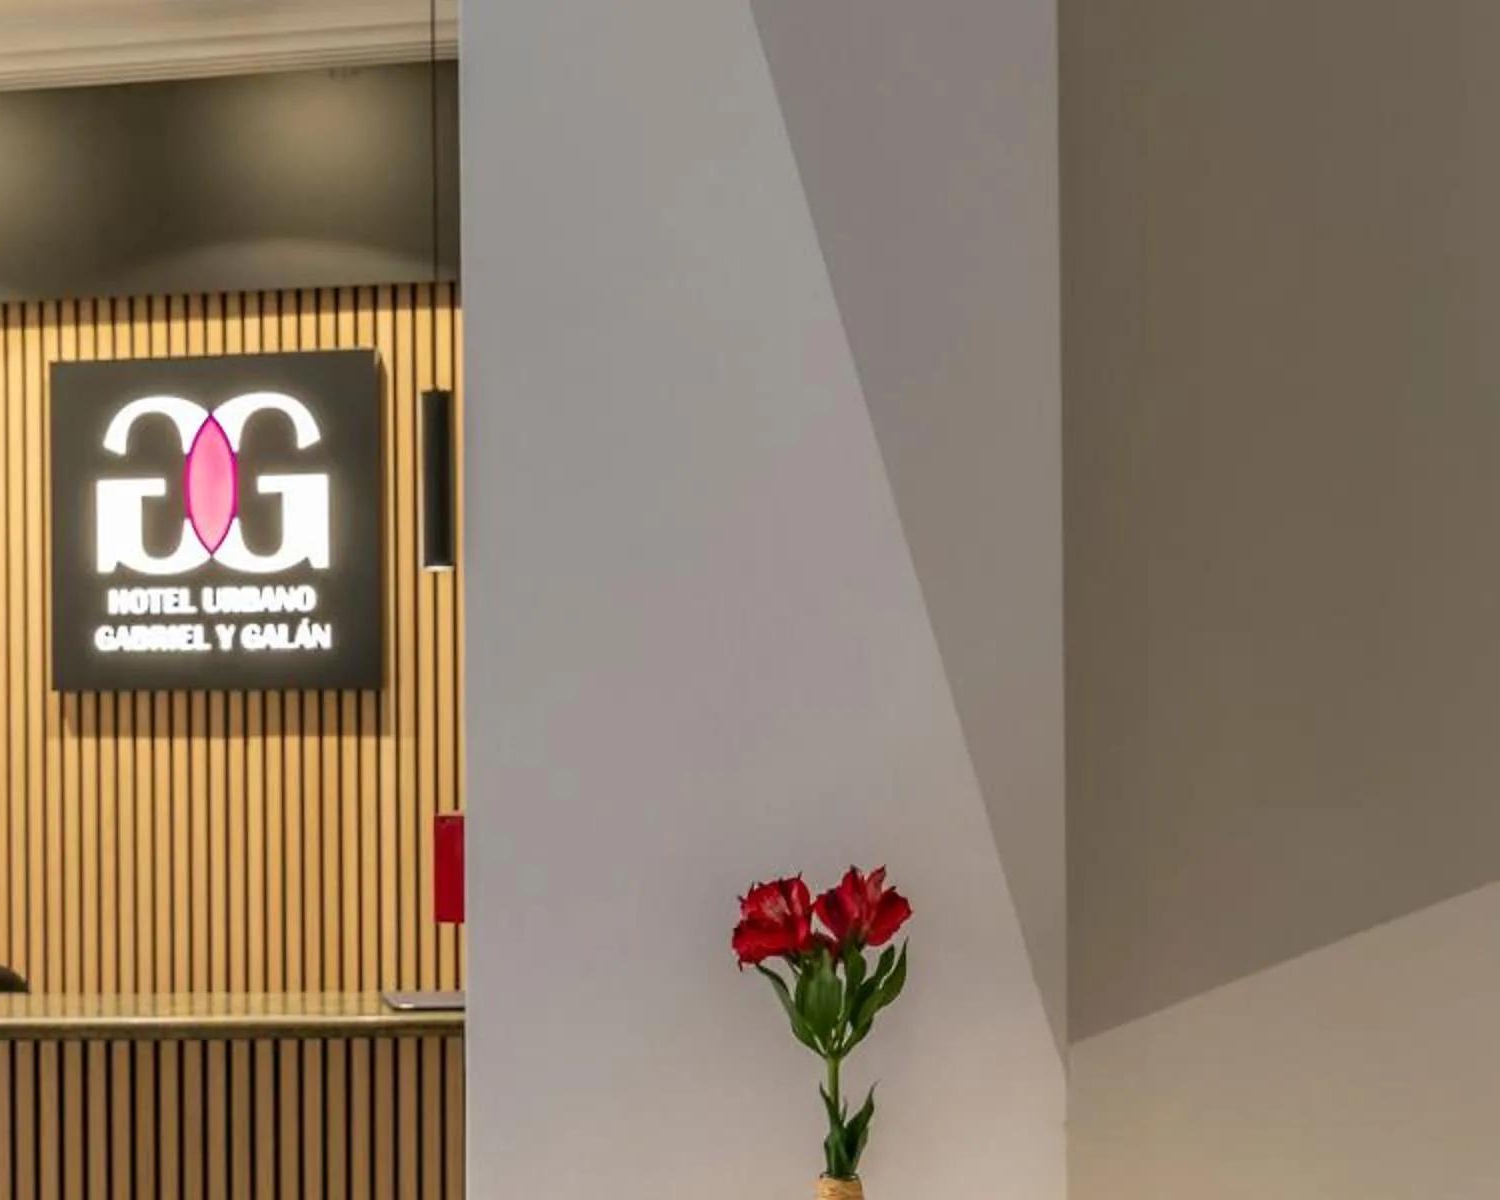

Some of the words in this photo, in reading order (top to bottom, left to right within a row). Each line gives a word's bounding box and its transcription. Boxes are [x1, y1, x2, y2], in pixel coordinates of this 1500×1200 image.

[108, 587, 198, 615] HOTEL
[202, 585, 318, 613] URBANO
[94, 624, 212, 651] GABRIEL
[214, 624, 236, 650] Y
[240, 618, 333, 650] GALÁN
